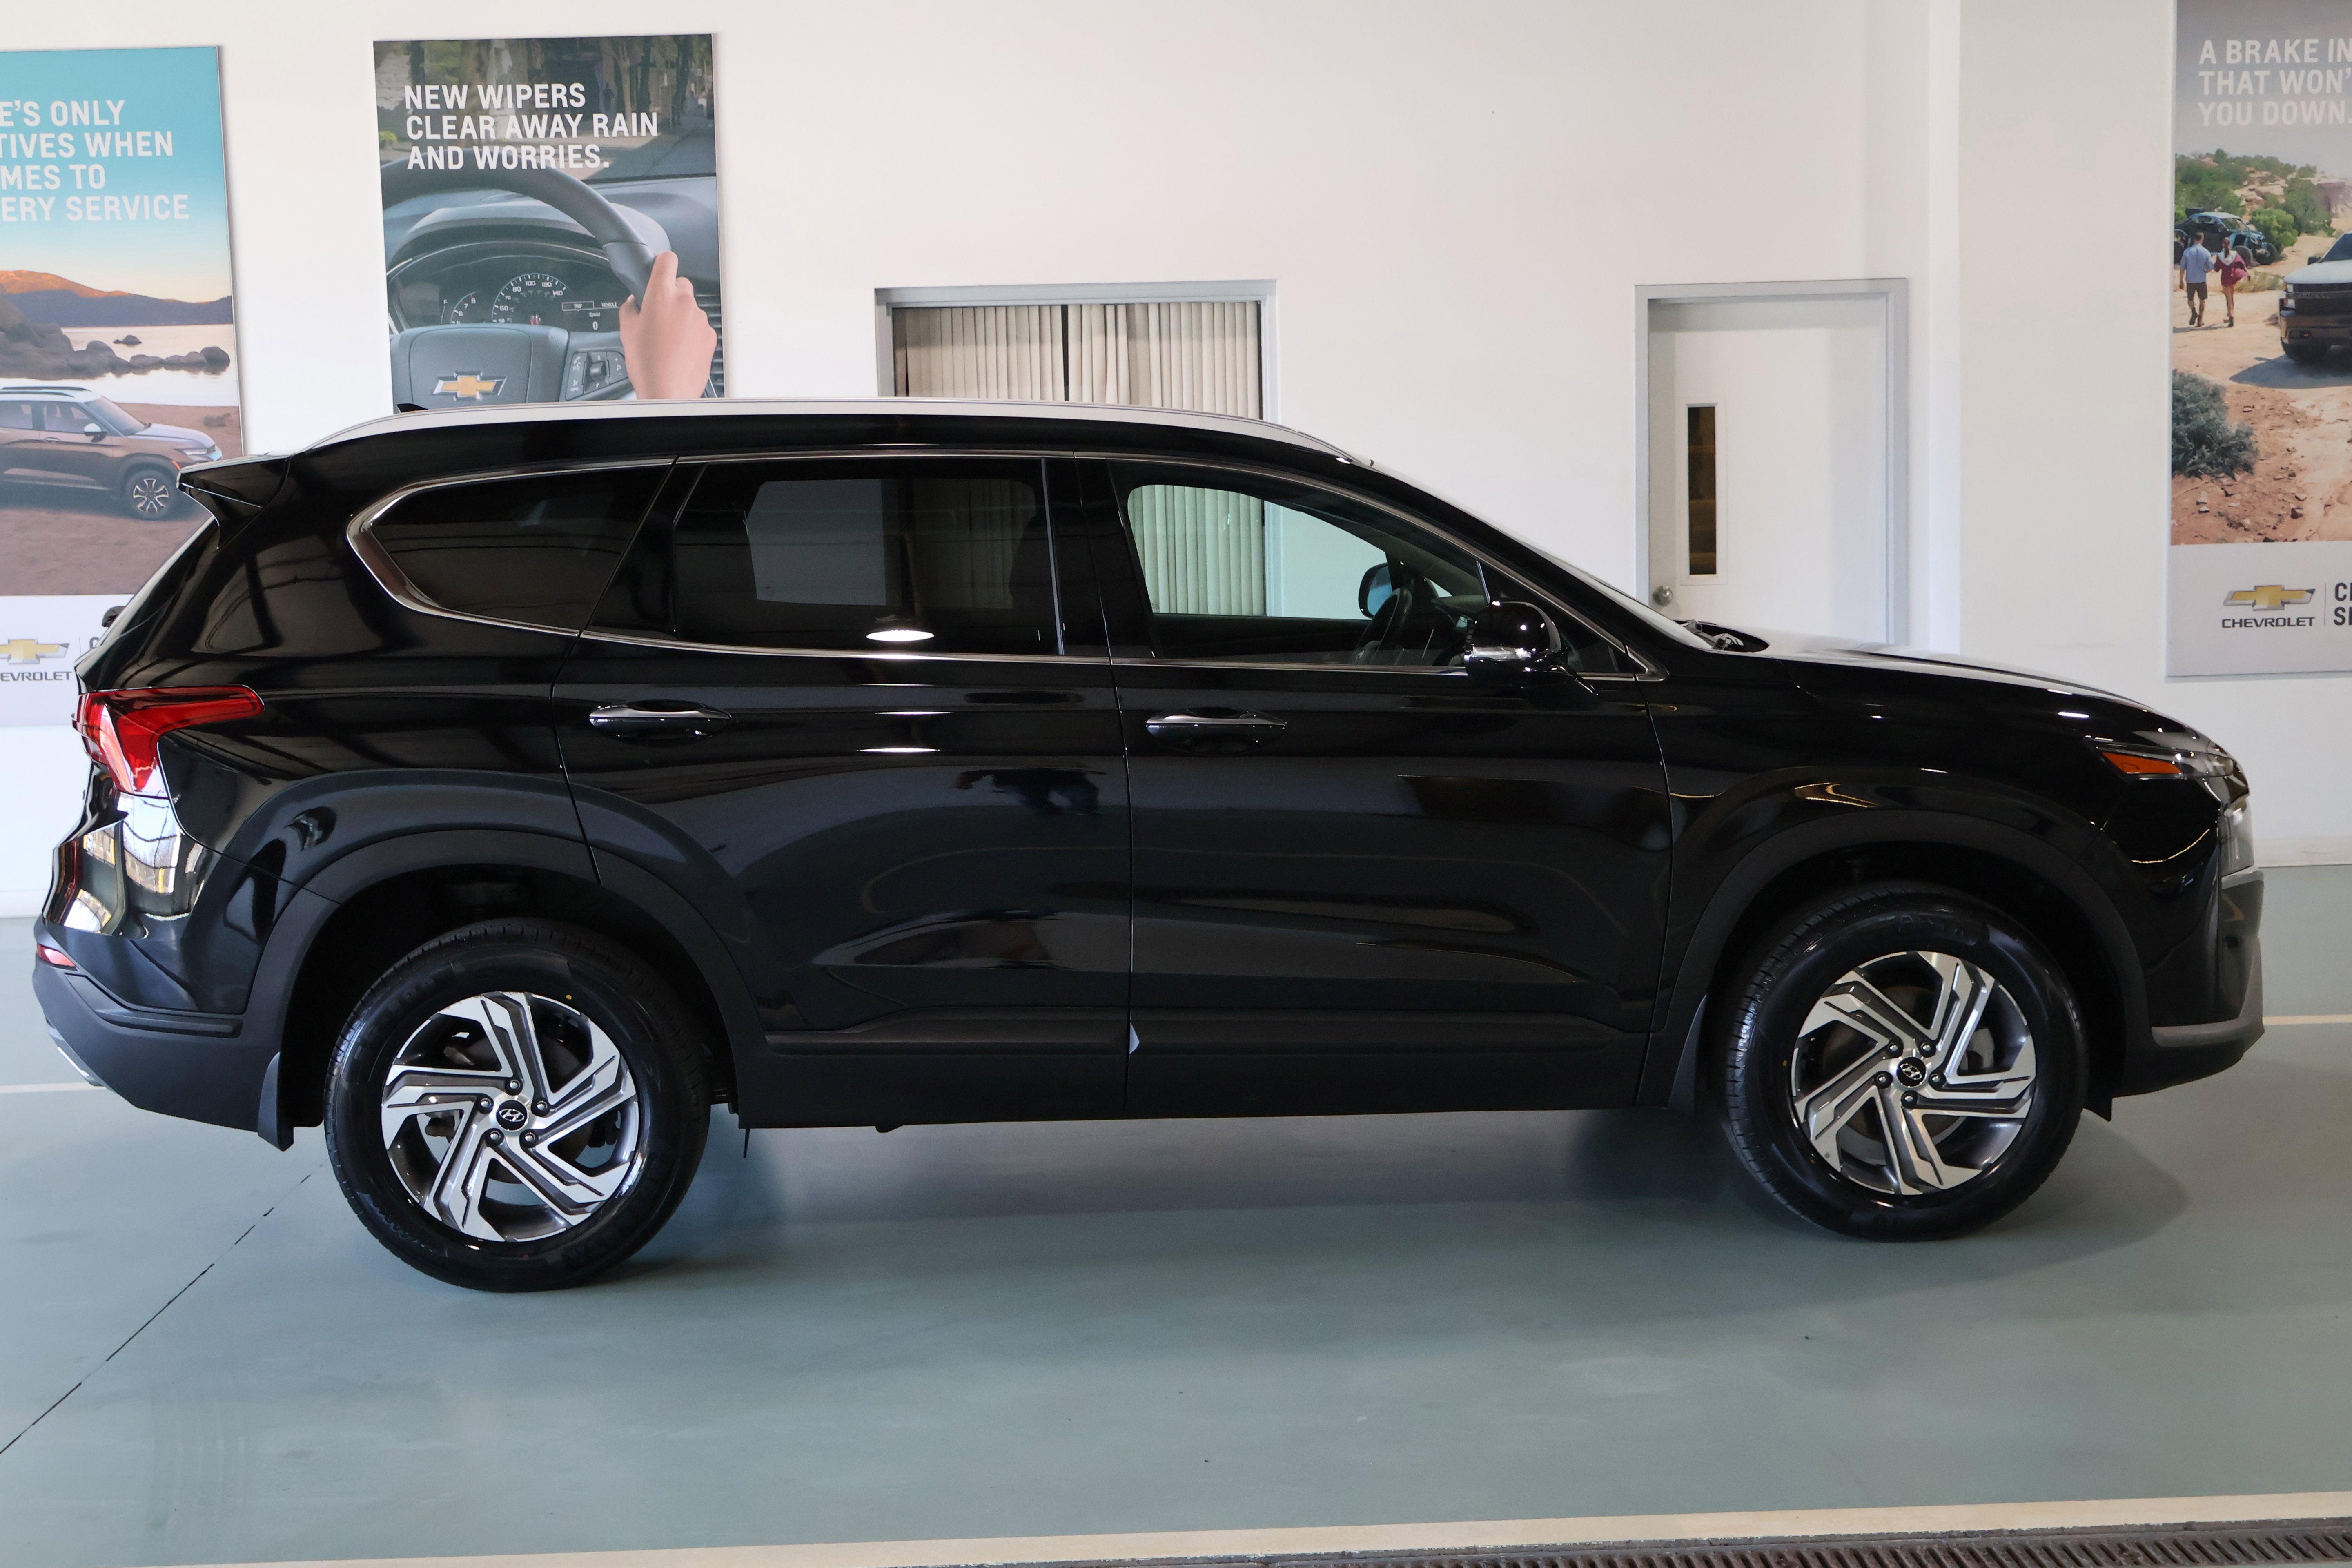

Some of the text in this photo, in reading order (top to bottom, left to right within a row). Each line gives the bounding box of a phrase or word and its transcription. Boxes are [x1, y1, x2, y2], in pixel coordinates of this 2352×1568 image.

[2199, 38, 2352, 64] A BRAKE IN
[2198, 68, 2351, 95] THAT WON'
[404, 83, 586, 109] NEW WIPERS
[0, 100, 125, 127] E'S ONLY
[407, 112, 658, 140] CLEAR AWAY RAIN
[2198, 100, 2352, 126] YOU DOWN.
[84, 131, 173, 157] WHEN
[407, 144, 610, 170] AND WORRIES.
[0, 164, 106, 190] MES TO
[1, 194, 189, 222] ERY SERVICE
[2335, 582, 2352, 601] C
[2222, 617, 2315, 628] CHEVROLET
[0, 672, 72, 681] EVROLET
